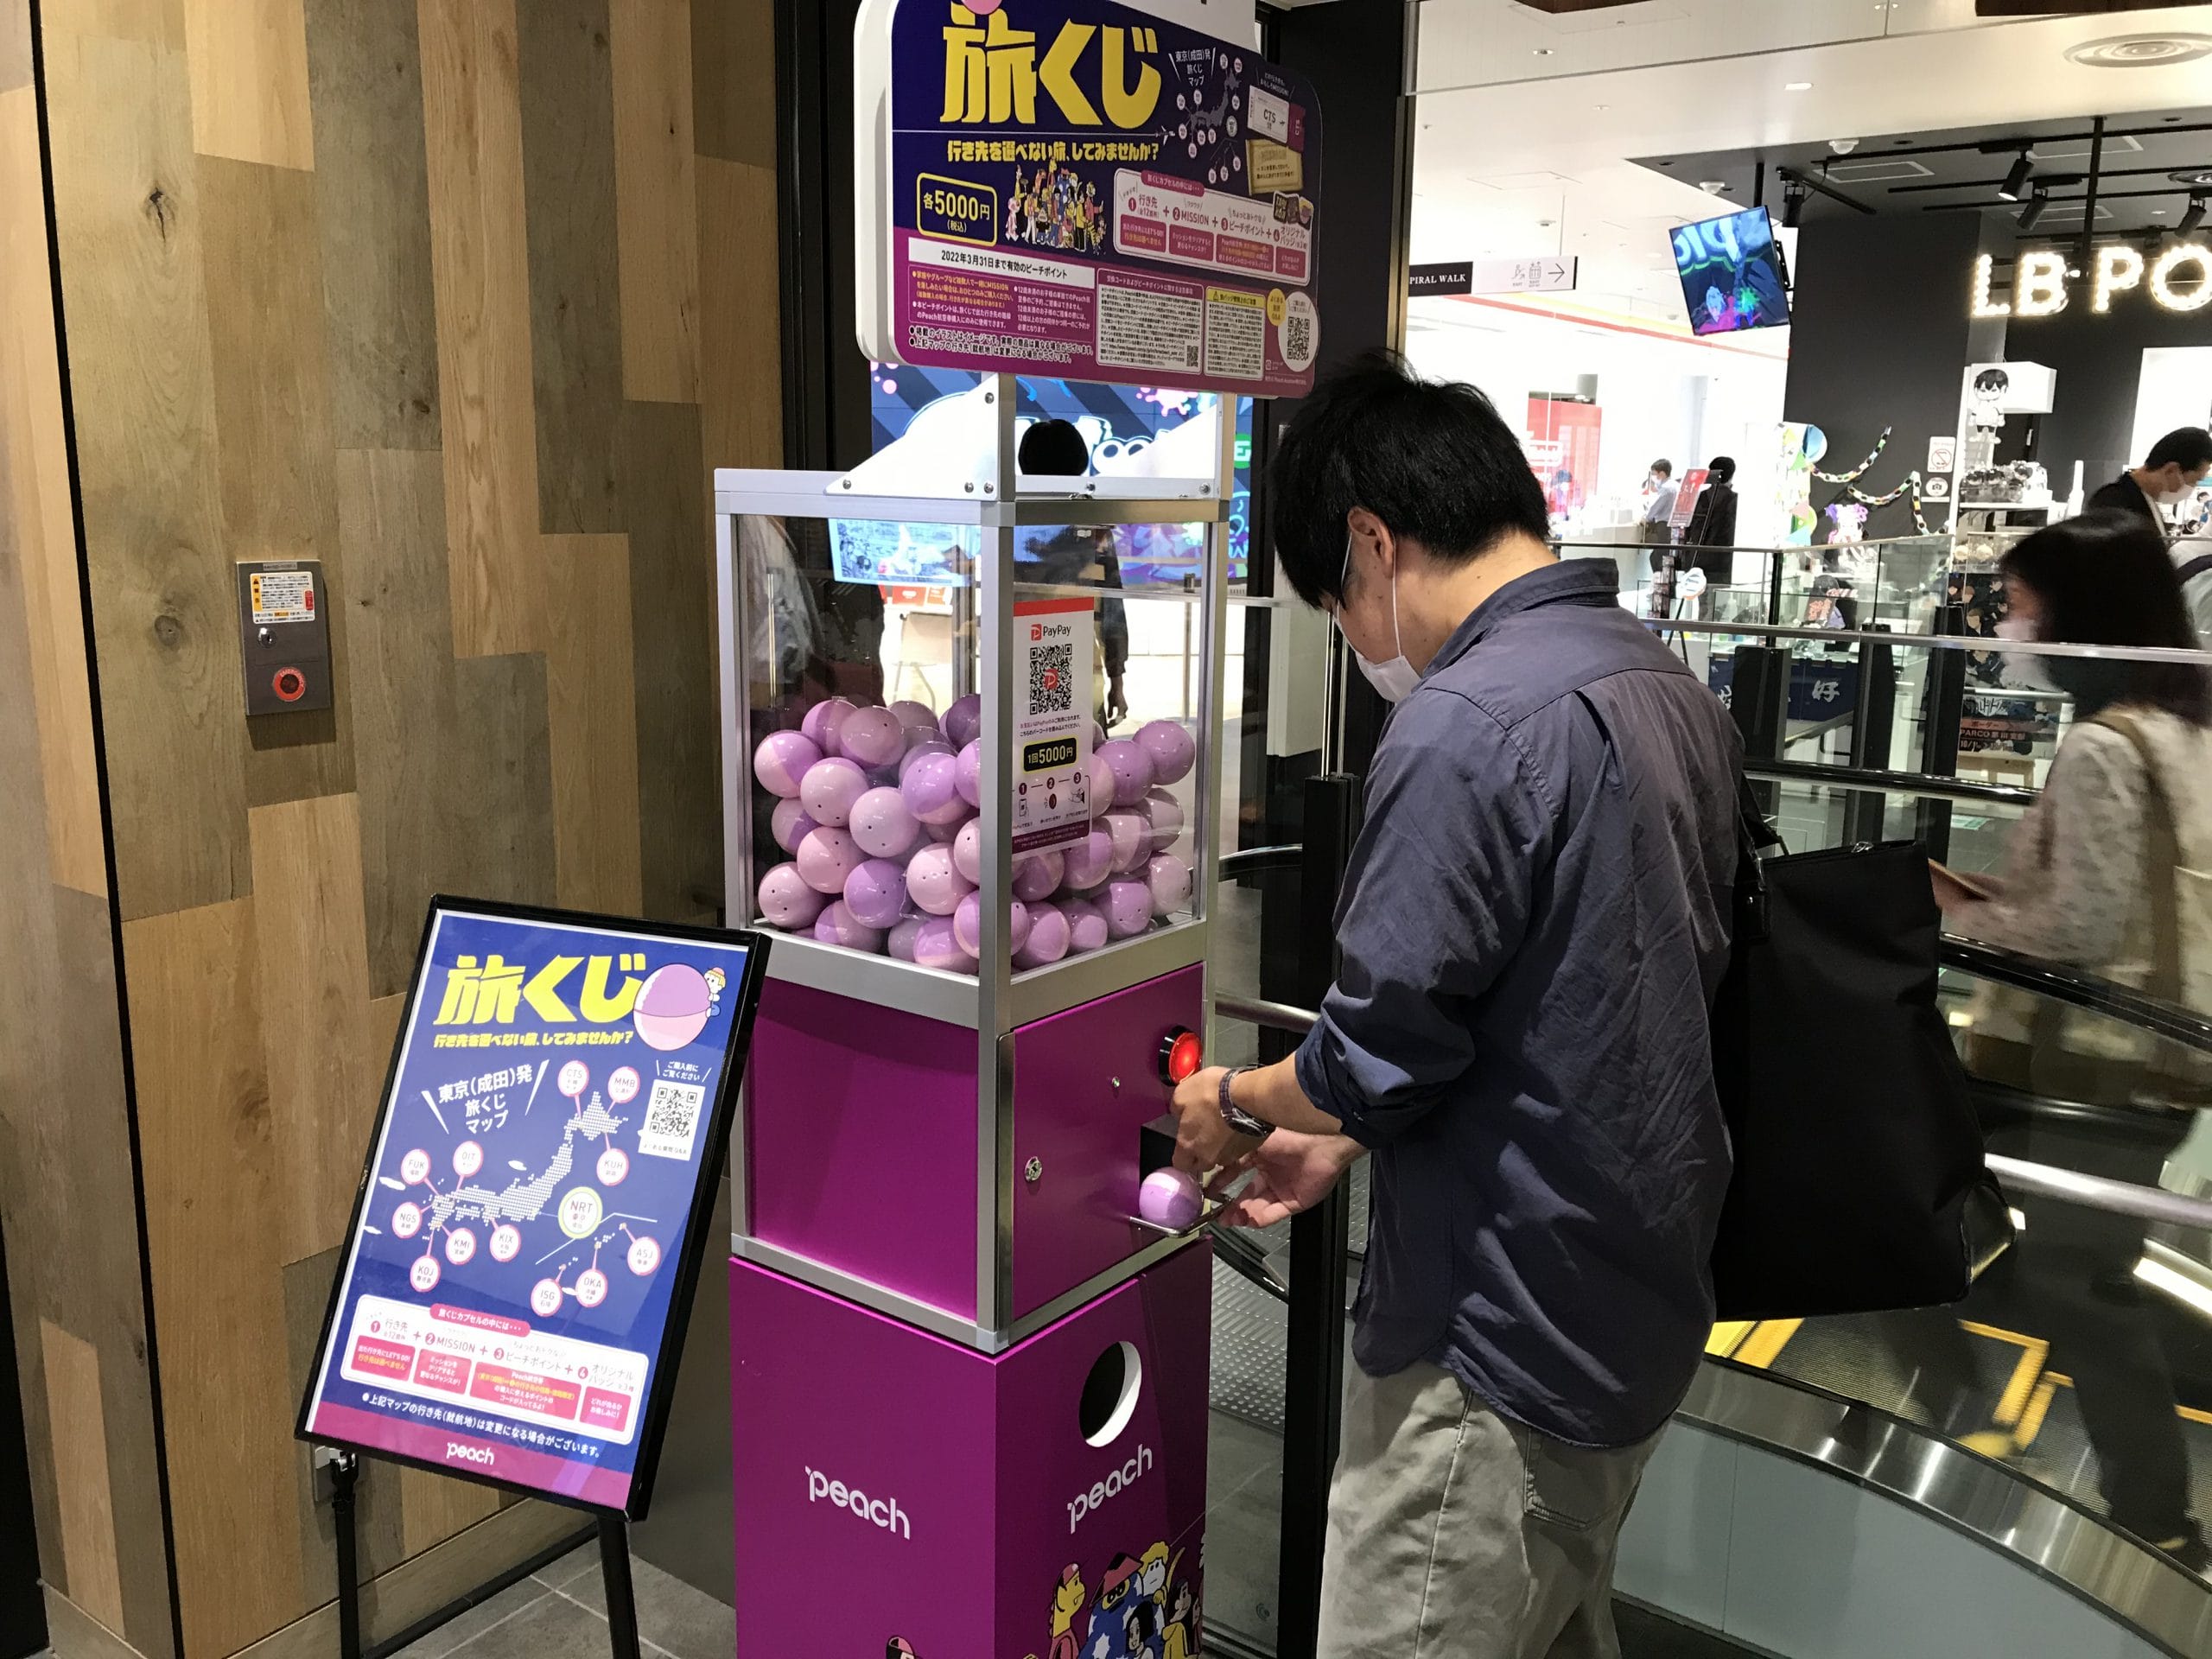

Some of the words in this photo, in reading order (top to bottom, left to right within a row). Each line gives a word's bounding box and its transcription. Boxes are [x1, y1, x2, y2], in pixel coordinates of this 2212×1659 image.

[940, 3, 1162, 129] 旅くじ
[923, 189, 990, 222] 各5000円
[1181, 211, 1209, 226] MISSION
[941, 250, 1068, 280] 2022年3月31日まで有効のピーチポイント
[1439, 274, 1466, 283] WALK
[1043, 625, 1071, 638] PayPay
[1027, 746, 1073, 765] 1回5000円
[433, 953, 646, 1026] 旅くじ
[566, 1069, 582, 1078] CTS
[438, 1064, 533, 1104] 東京(成田)発
[614, 1077, 635, 1088] MMB
[464, 1093, 506, 1117] 旅くじ
[465, 1109, 508, 1134] マップ
[408, 1160, 424, 1169] FUK
[604, 1160, 623, 1169] KUH
[570, 1200, 593, 1214] NRT
[399, 1213, 416, 1224] NGS
[454, 1239, 470, 1249] KMI
[499, 1233, 514, 1243] KIX
[636, 1249, 653, 1259] ASJ
[418, 1265, 434, 1276] KOJ
[583, 1277, 601, 1288] OKA
[540, 1289, 556, 1300] ISG
[385, 1318, 408, 1332] 行き先
[436, 1336, 475, 1353] MISSION
[505, 1351, 561, 1370] ピーチポイント
[591, 1363, 633, 1381] オリジナル
[368, 1393, 601, 1459] 上記マップの行き先(就航地)は変更になる場合がございます。
[447, 1442, 494, 1465] peach
[1067, 1443, 1152, 1534] peach
[804, 1465, 911, 1540] peach
